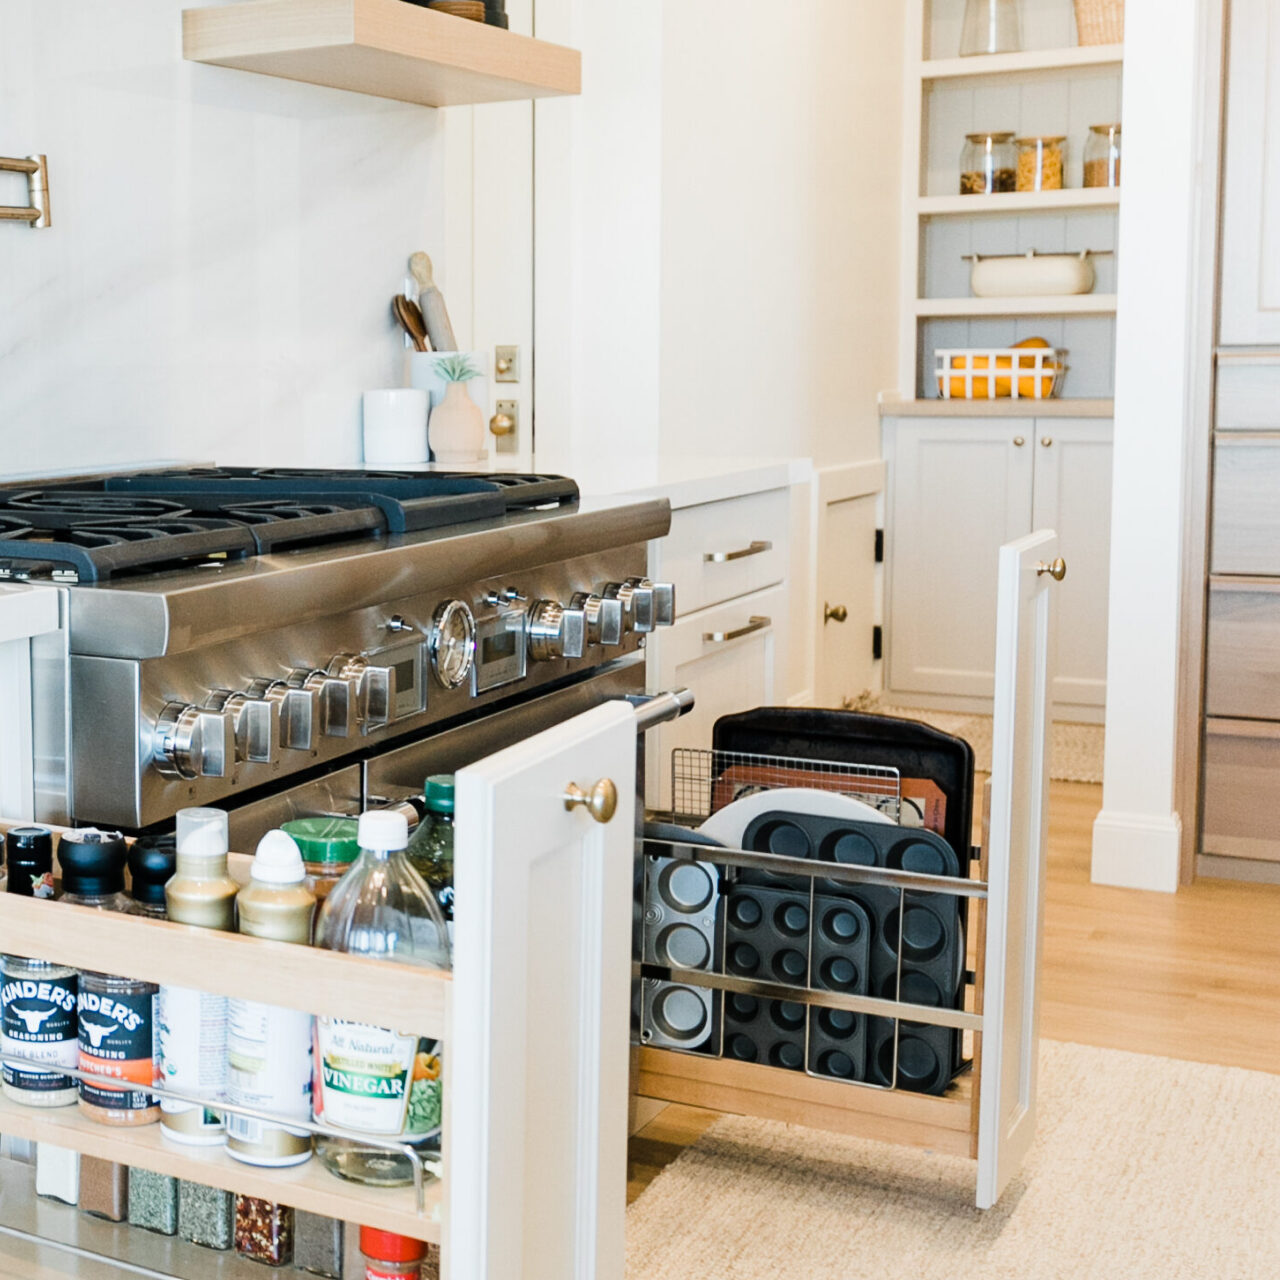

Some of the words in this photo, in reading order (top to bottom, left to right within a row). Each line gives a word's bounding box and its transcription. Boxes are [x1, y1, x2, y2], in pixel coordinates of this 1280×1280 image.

[1, 981, 76, 1012] KINDER'S
[78, 992, 141, 1032] NDER'S
[8, 1029, 63, 1042] SEASONING
[349, 1040, 395, 1055] Natural
[78, 1040, 126, 1060] EASONING
[323, 1067, 405, 1095] VINEGAR
